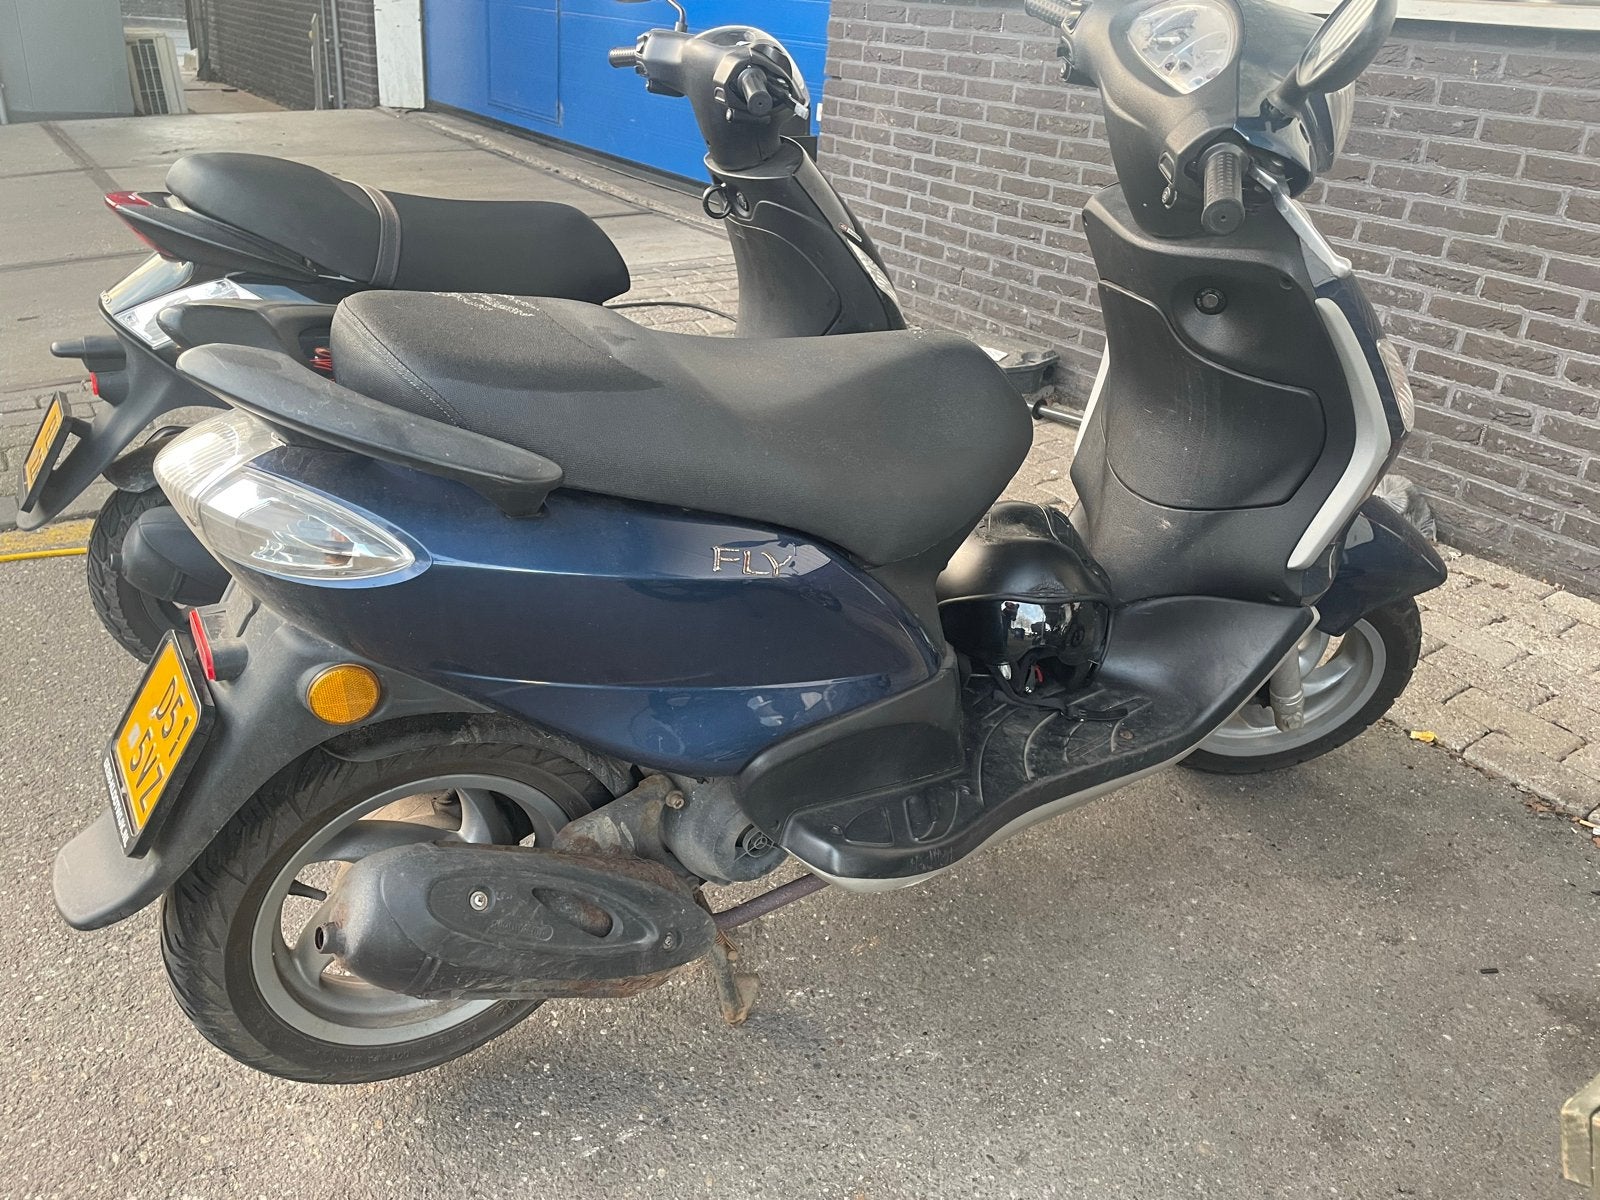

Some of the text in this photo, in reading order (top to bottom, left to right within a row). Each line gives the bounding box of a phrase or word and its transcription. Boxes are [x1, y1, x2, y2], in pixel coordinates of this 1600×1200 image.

[711, 545, 793, 577] FLY
[156, 677, 190, 757] D51
[130, 729, 164, 814] 5VZ
